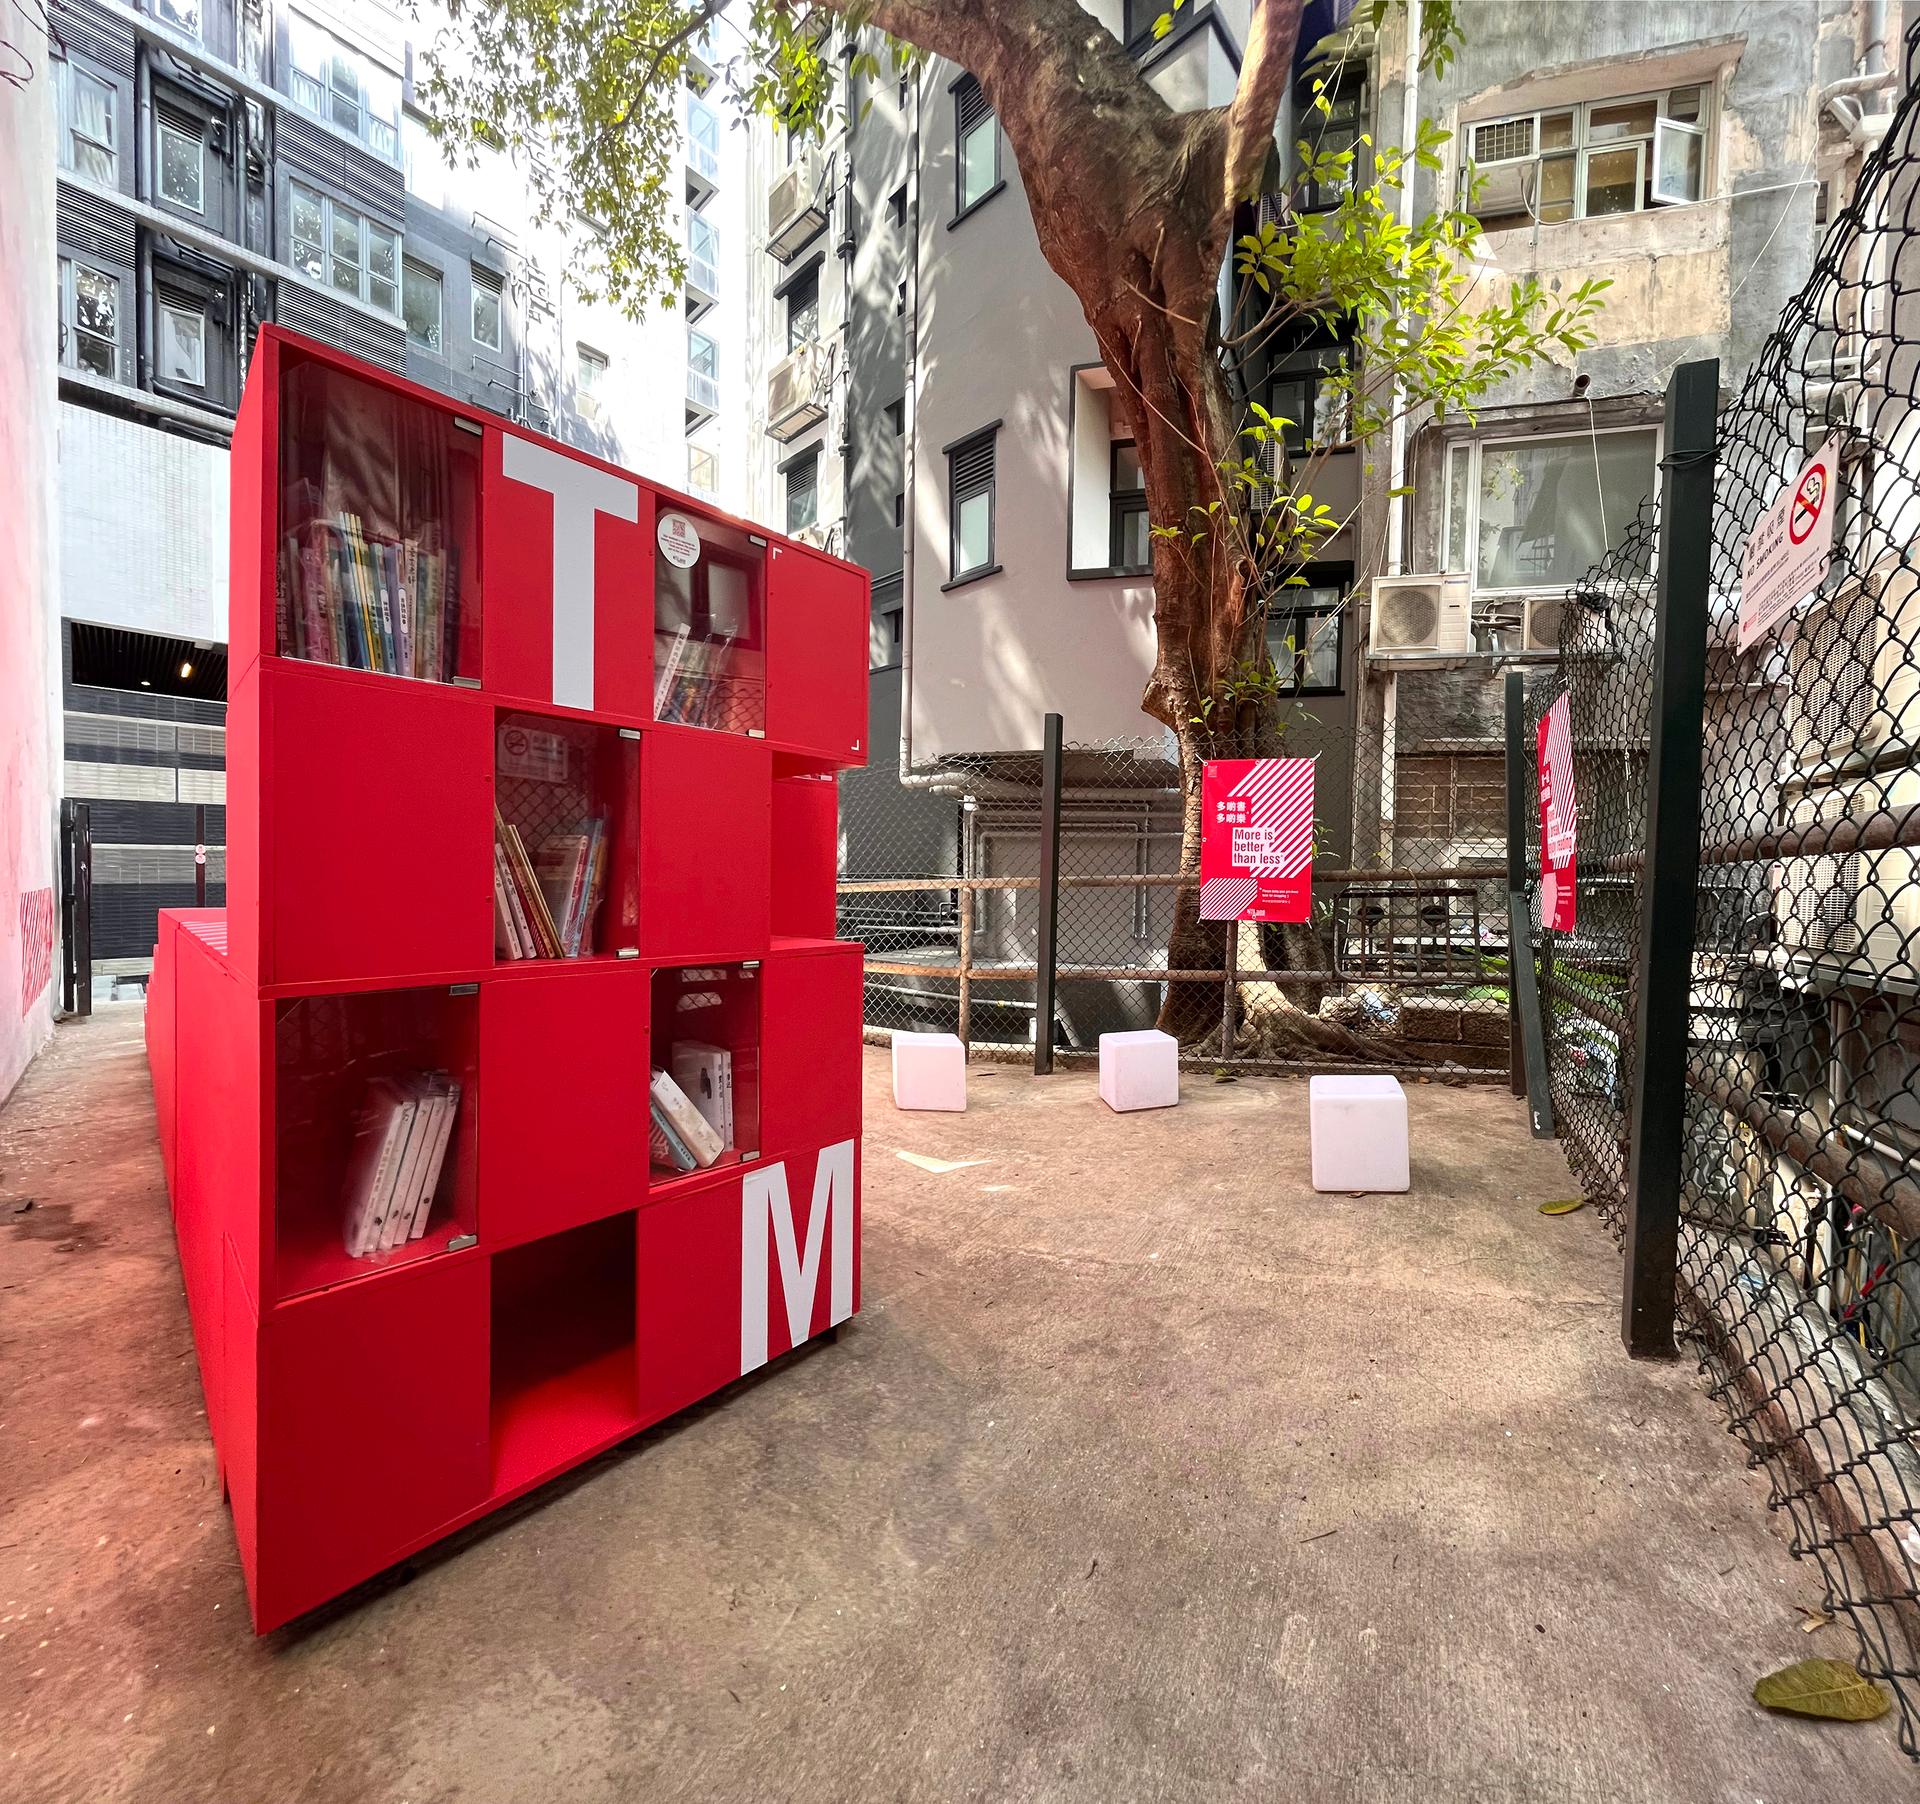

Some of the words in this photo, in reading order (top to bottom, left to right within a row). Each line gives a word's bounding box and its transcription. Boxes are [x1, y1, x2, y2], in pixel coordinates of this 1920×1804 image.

[1747, 564, 1755, 580] NO
[1756, 531, 1784, 570] SMOKING
[502, 432, 638, 711] T
[1234, 829, 1260, 840] More
[1264, 829, 1273, 840] is
[1234, 841, 1264, 852] better
[1234, 853, 1256, 864] than
[740, 1139, 855, 1376] M
